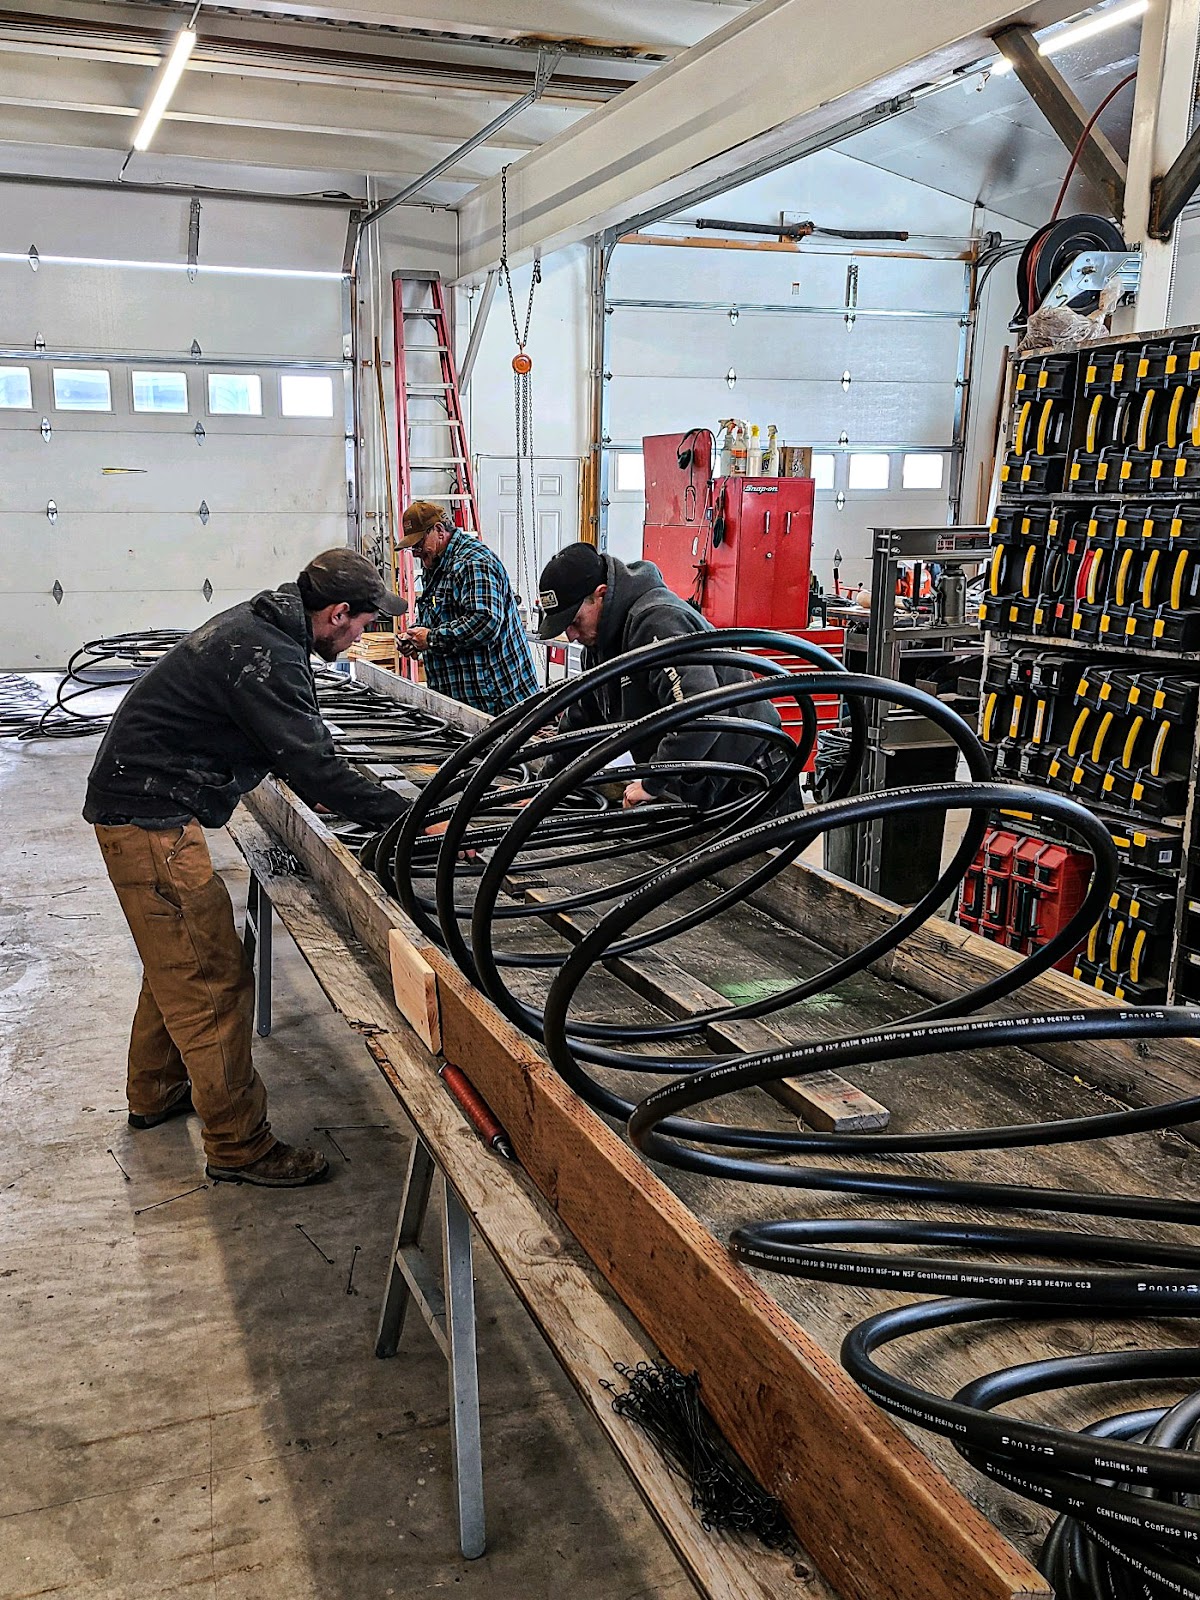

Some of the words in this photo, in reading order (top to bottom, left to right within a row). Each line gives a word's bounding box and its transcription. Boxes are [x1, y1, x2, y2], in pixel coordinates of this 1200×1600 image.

[744, 485, 778, 494] Snap-on
[841, 1039, 860, 1049] ASTM
[861, 1035, 882, 1045] D3035
[912, 1029, 926, 1037] NSF
[928, 1023, 970, 1035] Geothermal
[839, 1263, 855, 1272] ASTM
[856, 1265, 874, 1274] D3035
[876, 1267, 900, 1277] NSF-pw
[902, 1270, 915, 1278] NSF
[917, 1271, 959, 1282] Geothermal
[961, 1274, 1007, 1286] AWWA-C901
[1009, 1278, 1025, 1286] NSF
[1027, 1279, 1042, 1287] 358
[1045, 1280, 1073, 1288] PE4710
[1075, 1281, 1091, 1289] CC3
[954, 1424, 967, 1433] CC3
[1136, 1465, 1149, 1474] NE
[1067, 1498, 1085, 1508] 3/4"
[1096, 1506, 1142, 1527] CENTENNIAL
[1144, 1520, 1181, 1537] CenFuse
[1184, 1530, 1199, 1541] IPS
[1131, 1558, 1143, 1570] NSF
[1143, 1565, 1181, 1593] Geothermal
